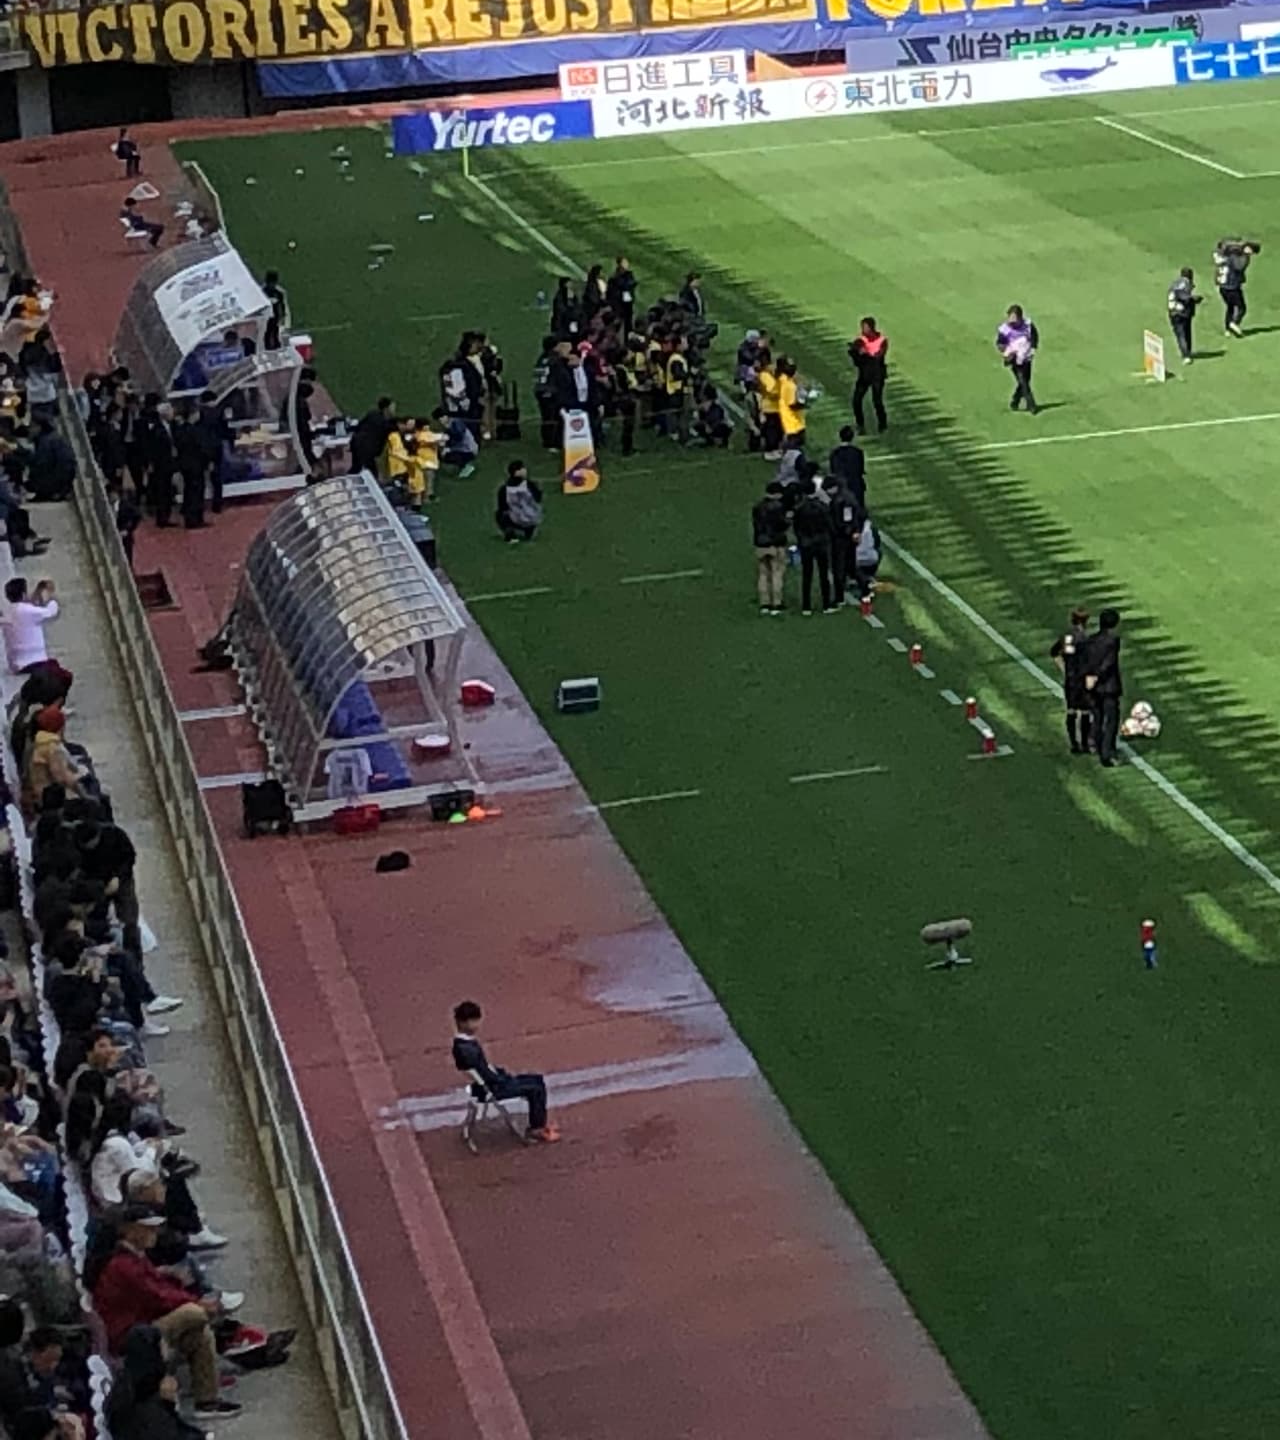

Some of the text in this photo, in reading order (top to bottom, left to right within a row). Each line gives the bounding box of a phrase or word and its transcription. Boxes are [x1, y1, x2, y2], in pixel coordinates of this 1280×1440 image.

[603, 54, 739, 95] 日進工具
[842, 68, 973, 110] 東北電力
[615, 87, 772, 128] 河北新報
[427, 110, 556, 151] Yurtec
